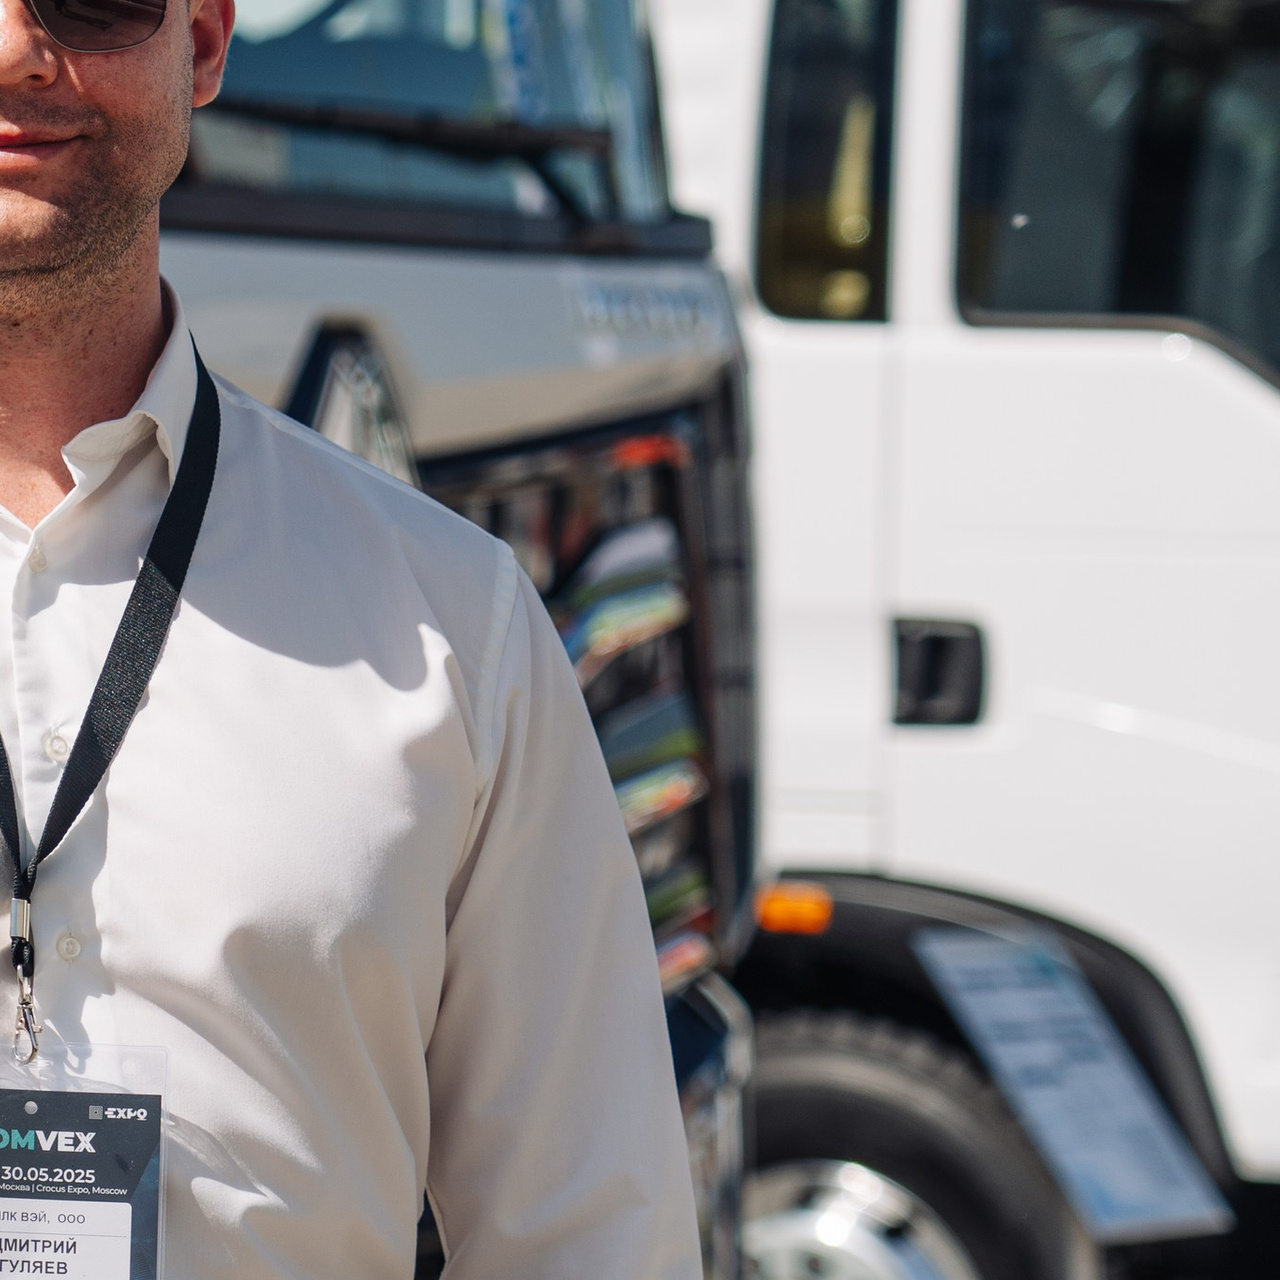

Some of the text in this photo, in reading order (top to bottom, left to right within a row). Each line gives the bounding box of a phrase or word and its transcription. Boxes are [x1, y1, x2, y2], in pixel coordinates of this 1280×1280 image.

[104, 1107, 148, 1121] EXPO
[36, 1184, 66, 1193] Crocus
[67, 1185, 91, 1195] Expo,
[91, 1186, 128, 1195] Moscow
[20, 1210, 51, 1224] ВЭЙ,
[57, 1213, 86, 1224] ООО
[0, 1259, 69, 1275] ГУЛЯЕВ
